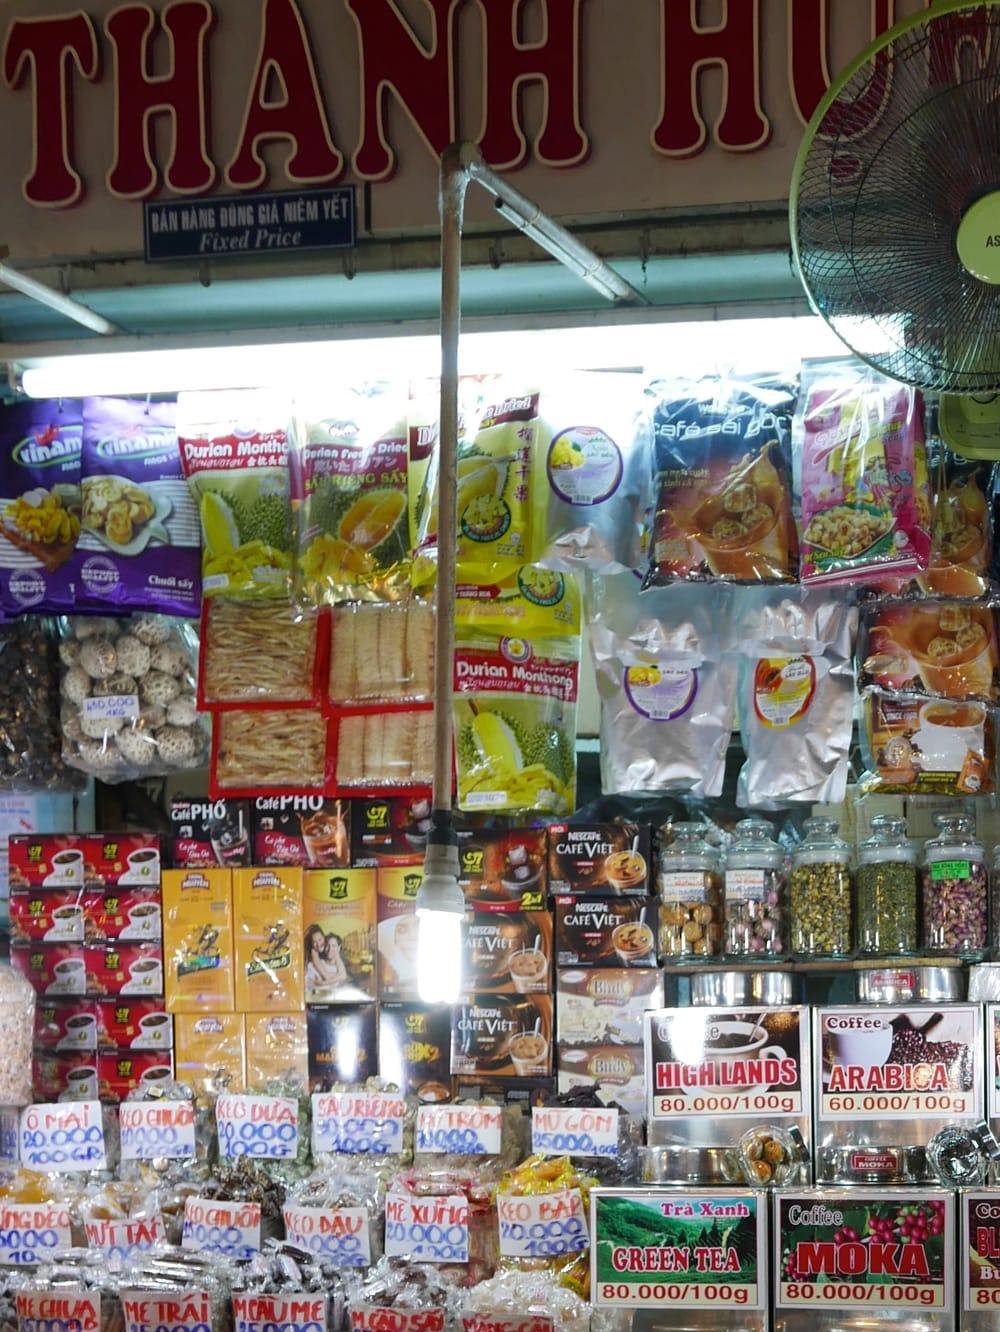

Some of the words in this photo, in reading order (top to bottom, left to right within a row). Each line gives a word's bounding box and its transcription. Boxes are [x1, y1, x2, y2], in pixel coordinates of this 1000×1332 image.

[3, 0, 590, 208] THANH
[152, 207, 178, 233] BÁN
[182, 205, 216, 231] HÀNG
[220, 202, 254, 227] ĐÚNG
[259, 199, 280, 225] GIÁ
[323, 192, 349, 219] YẾT
[200, 229, 249, 252] Fixed
[255, 228, 302, 248] Price
[184, 443, 232, 460] Durian
[456, 661, 508, 678] Durian
[512, 666, 574, 690] Monthong
[556, 843, 583, 854] CAFÉ
[564, 914, 590, 925] CAFÉ
[826, 1015, 882, 1031] Coffee
[828, 1063, 952, 1091] ARABICA
[660, 1095, 795, 1113] 80.000/100g
[829, 1095, 966, 1113] 60.000/100g
[45, 1105, 90, 1129] MAI
[23, 1126, 103, 1149] 20.000
[858, 1162, 894, 1170] MOKA
[662, 1202, 694, 1217] Trà
[700, 1202, 751, 1217] Xanh
[789, 1204, 844, 1227] Coffee
[612, 1247, 690, 1273] GREEN
[695, 1247, 742, 1273] TEA
[797, 1241, 930, 1276] MOKA
[602, 1285, 748, 1304] 80.000/100g
[786, 1284, 935, 1305] 80.000/100g
[125, 1301, 149, 1323] ME
[153, 1293, 209, 1323] TRÁI
